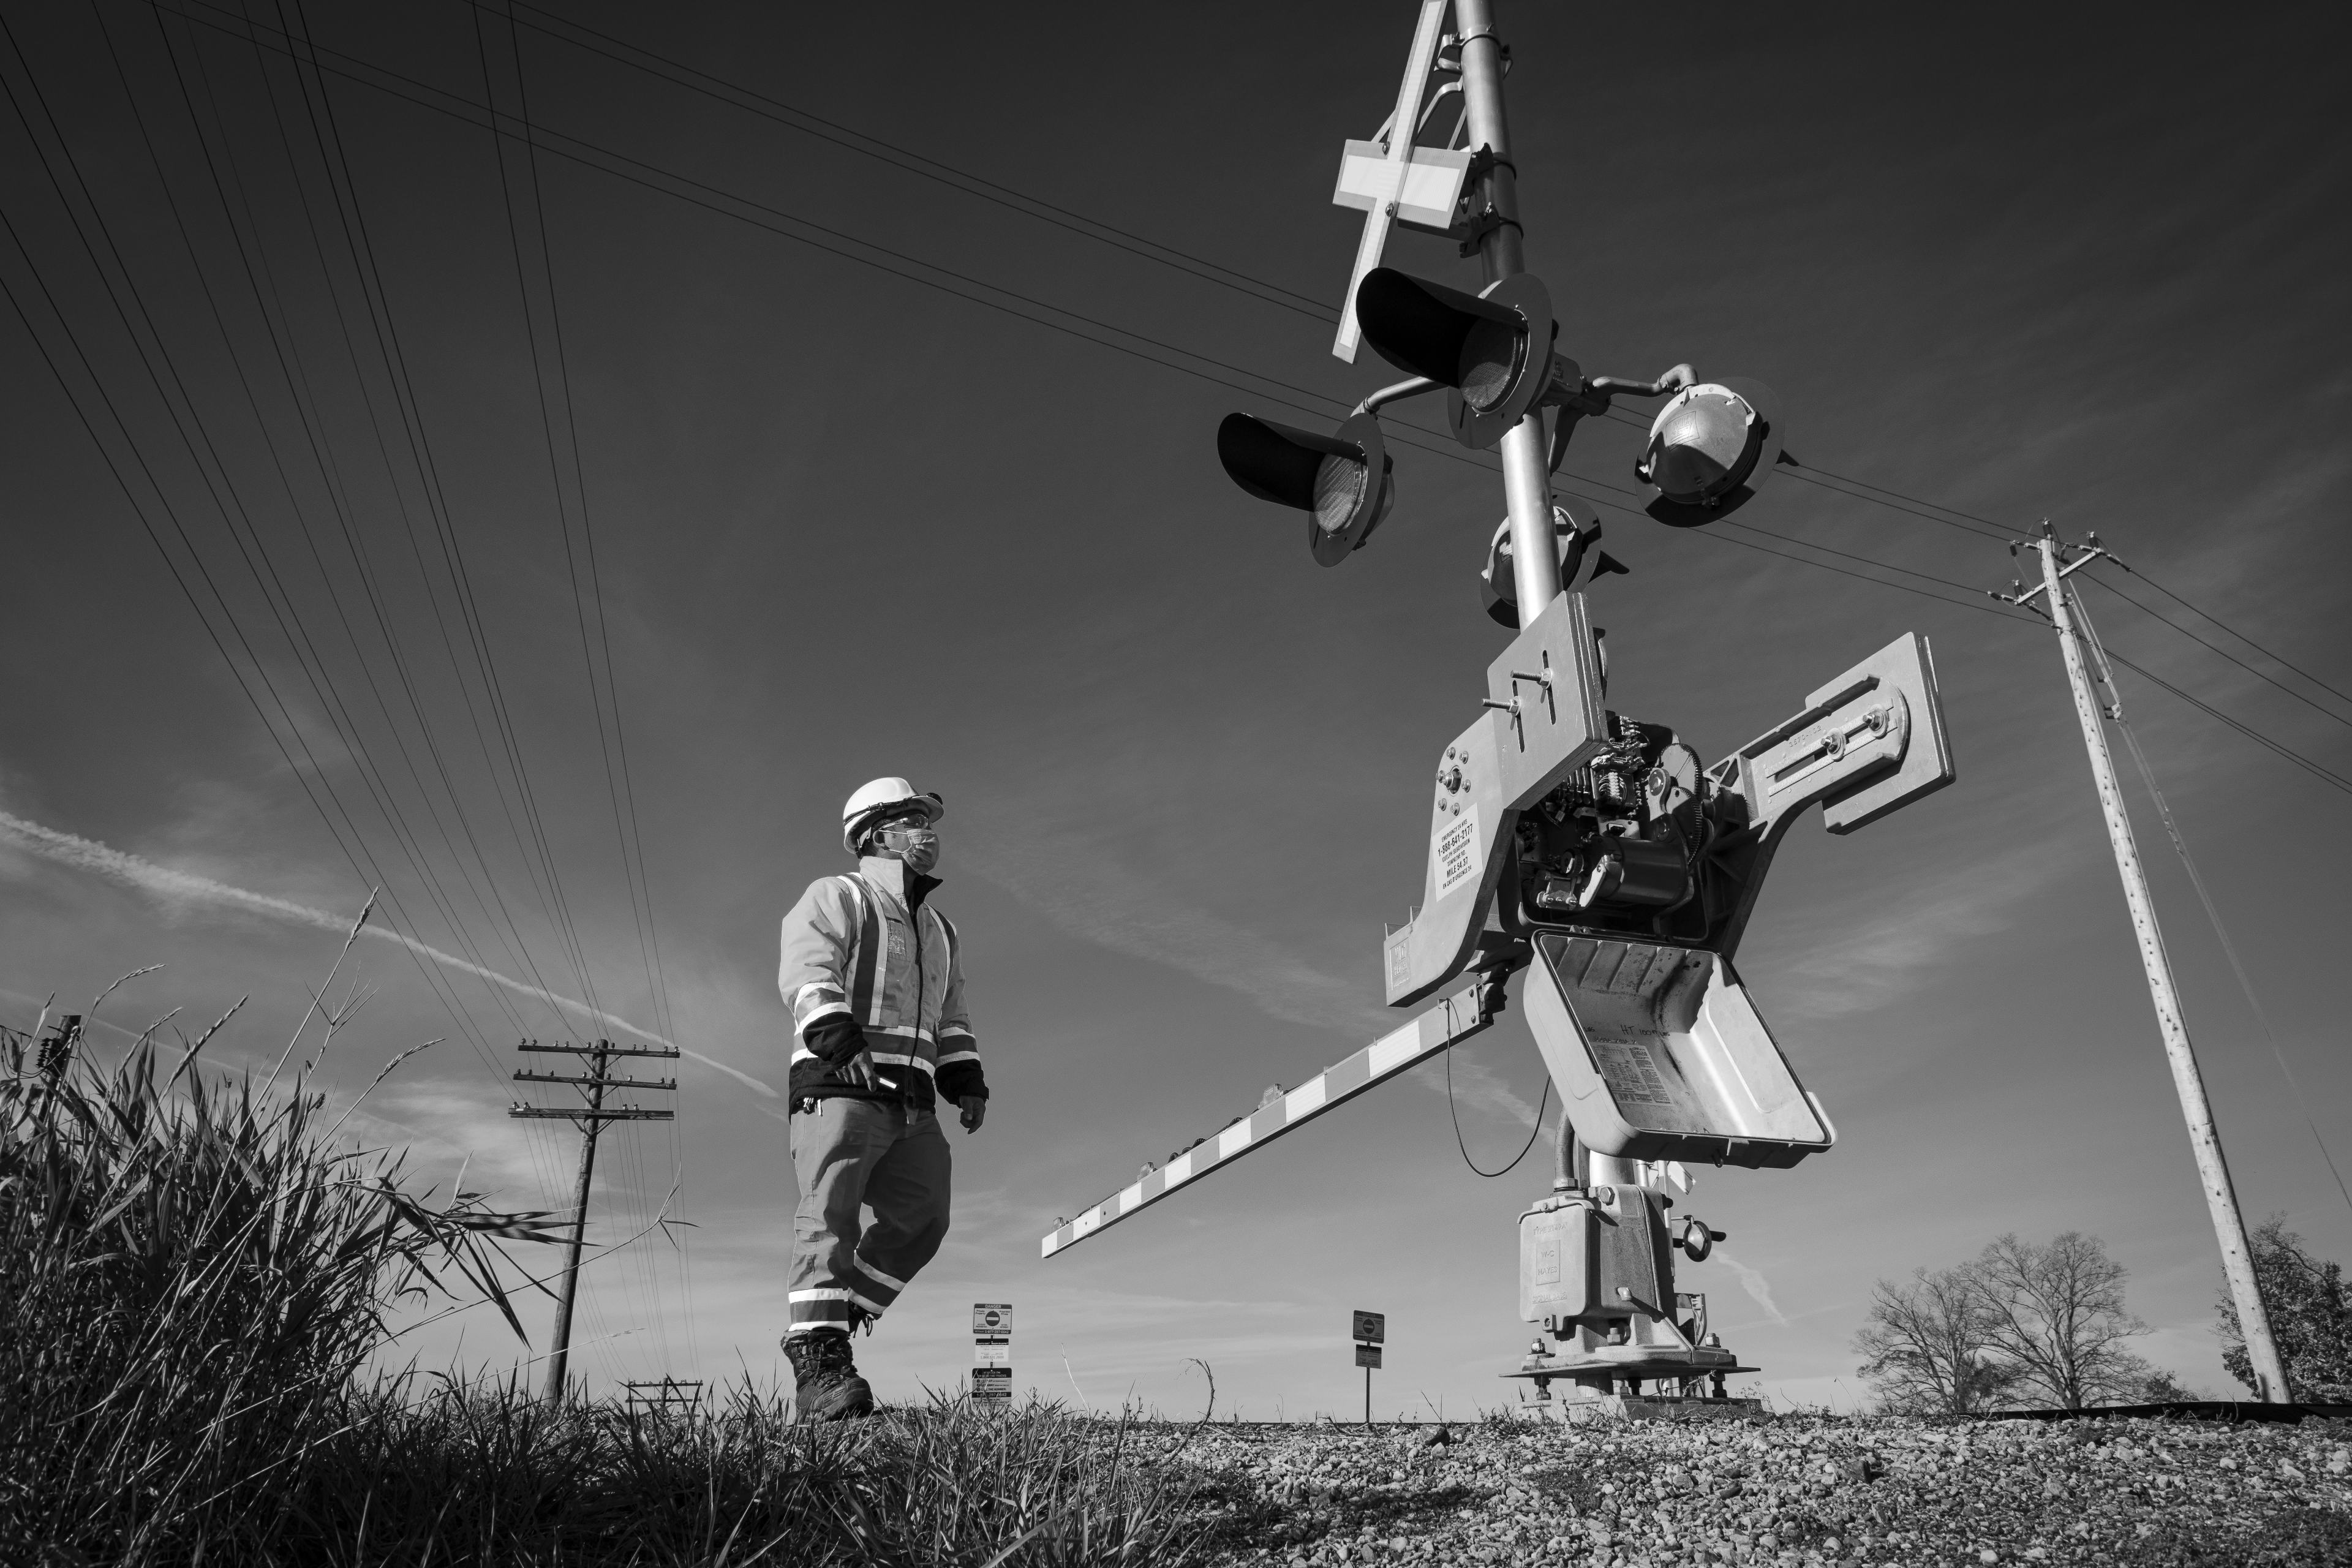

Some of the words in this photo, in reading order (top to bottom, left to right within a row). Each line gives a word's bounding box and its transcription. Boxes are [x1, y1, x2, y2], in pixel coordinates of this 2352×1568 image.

[1438, 823, 1473, 856] 1-888-641-2177
[1442, 827, 1457, 842] EMERGENCY
[1442, 850, 1453, 862] GUELPH
[1453, 837, 1470, 854] SUBDIVISION
[1447, 853, 1461, 867] TOWNLINE
[1447, 864, 1457, 878] MILE
[1457, 856, 1468, 870] 54.37
[1538, 1265, 1558, 1275] HAYES
